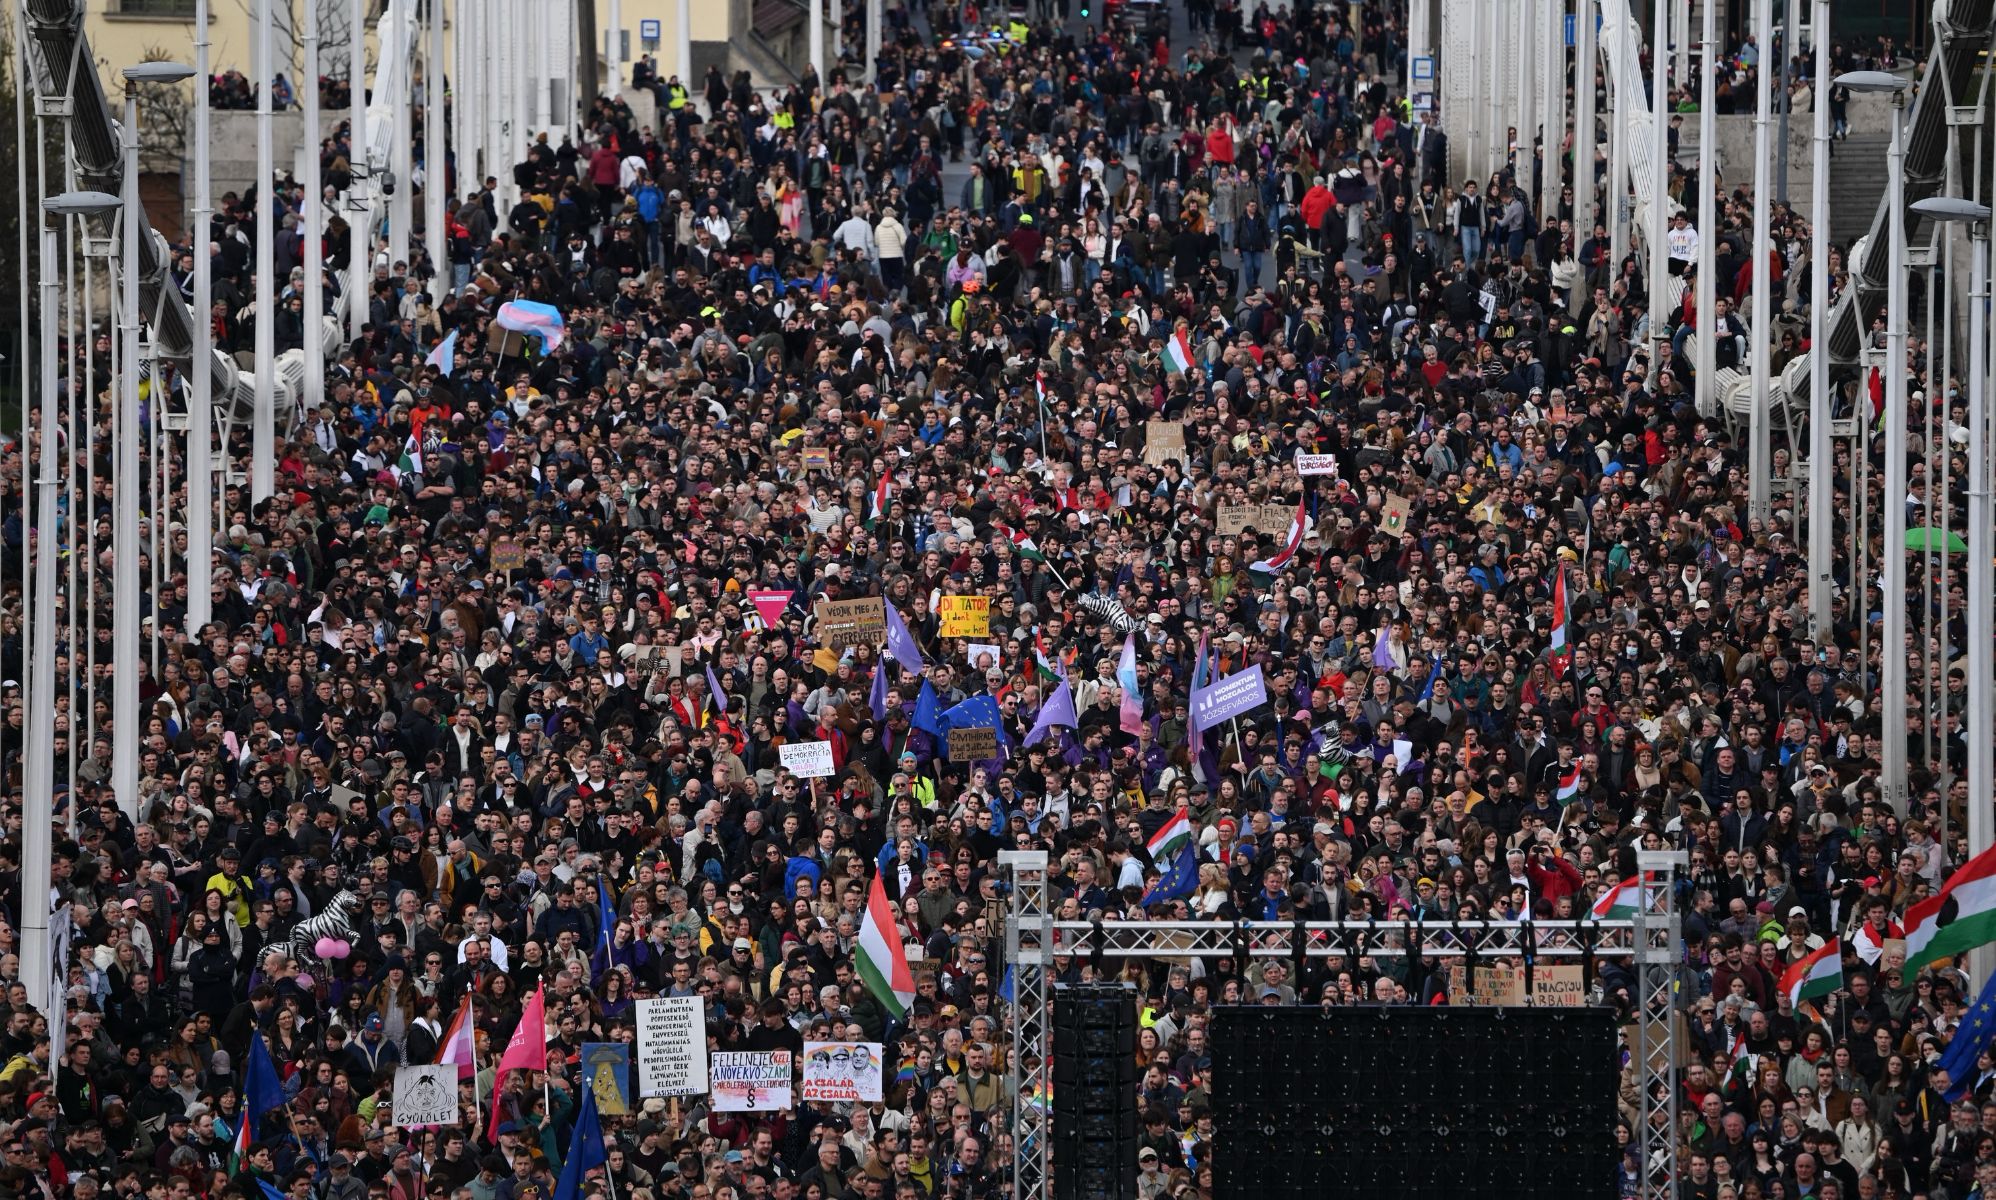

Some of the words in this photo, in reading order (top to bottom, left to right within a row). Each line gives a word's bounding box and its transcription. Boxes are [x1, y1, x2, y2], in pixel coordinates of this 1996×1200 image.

[854, 604, 870, 615] MEG
[872, 603, 879, 612] A
[1214, 673, 1256, 697] MOMENTUM
[1216, 681, 1258, 705] MOZGALOM
[1202, 690, 1260, 722] JÓZSEFVÁROS
[1537, 981, 1583, 993] HAGYJU
[648, 1006, 694, 1015] PARLAMENTBEN
[651, 1064, 671, 1072] HALOTT
[713, 1067, 720, 1080] A
[805, 1079, 813, 1087] A
[814, 1077, 854, 1087] CSALÁD
[804, 1088, 819, 1098] AZ
[820, 1087, 859, 1099] CSALÁD
